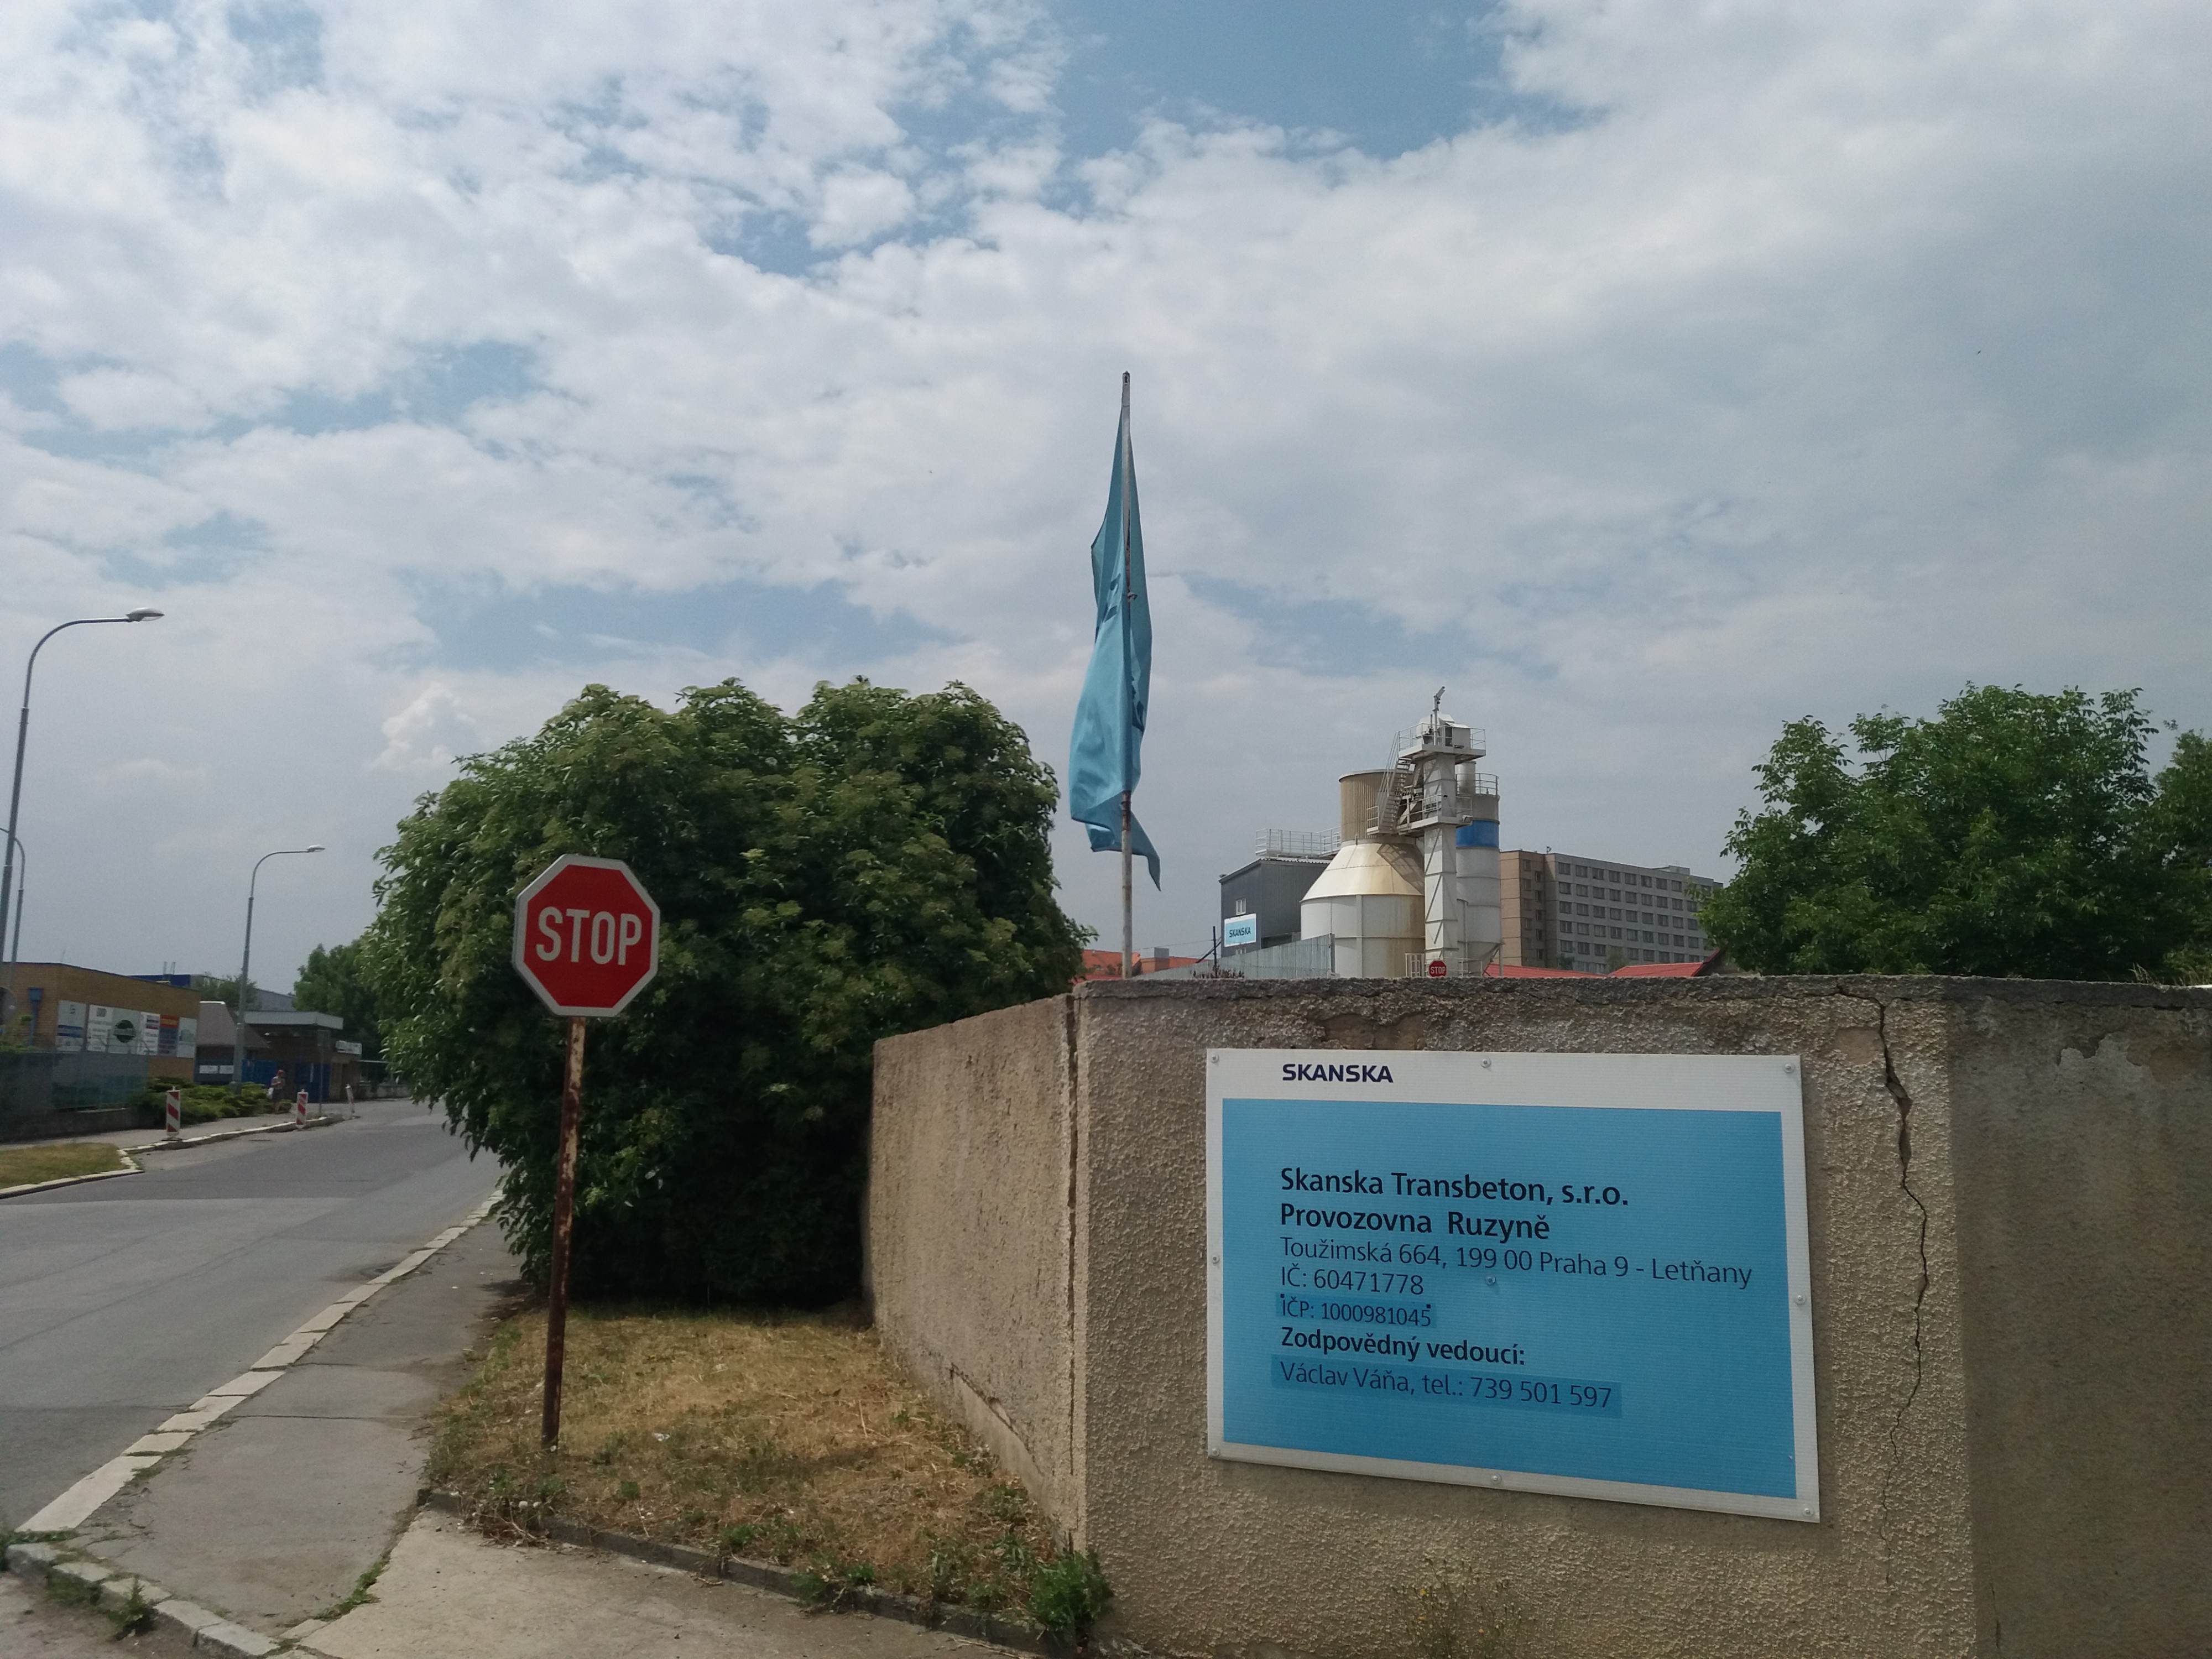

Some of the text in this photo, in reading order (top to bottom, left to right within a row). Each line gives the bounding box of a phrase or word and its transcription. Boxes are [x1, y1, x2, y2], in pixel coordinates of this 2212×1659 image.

[536, 906, 642, 966] STOP
[1229, 927, 1251, 937] SKANSKA
[1282, 1063, 1394, 1083] SKANSKA
[1281, 1167, 1628, 1206] Skanska Transbeton, s.r.o.
[1281, 1203, 1550, 1244] Provozovna Ruzyně
[1280, 1237, 1392, 1262] Toužimská
[1399, 1244, 1447, 1269] 664,
[1457, 1247, 1497, 1268] 199
[1504, 1249, 1532, 1270] 00
[1540, 1251, 1606, 1275] Praha
[1614, 1256, 1629, 1277] 9
[1652, 1258, 1752, 1290] Letňany
[1281, 1262, 1423, 1295] IČ: 60471778
[1280, 1296, 1431, 1327] IČP: 1000981045
[1281, 1326, 1525, 1365] Zodpovědný vedoucí:
[1280, 1361, 1612, 1408] Václav Váňa, tel.: 739 501 597
